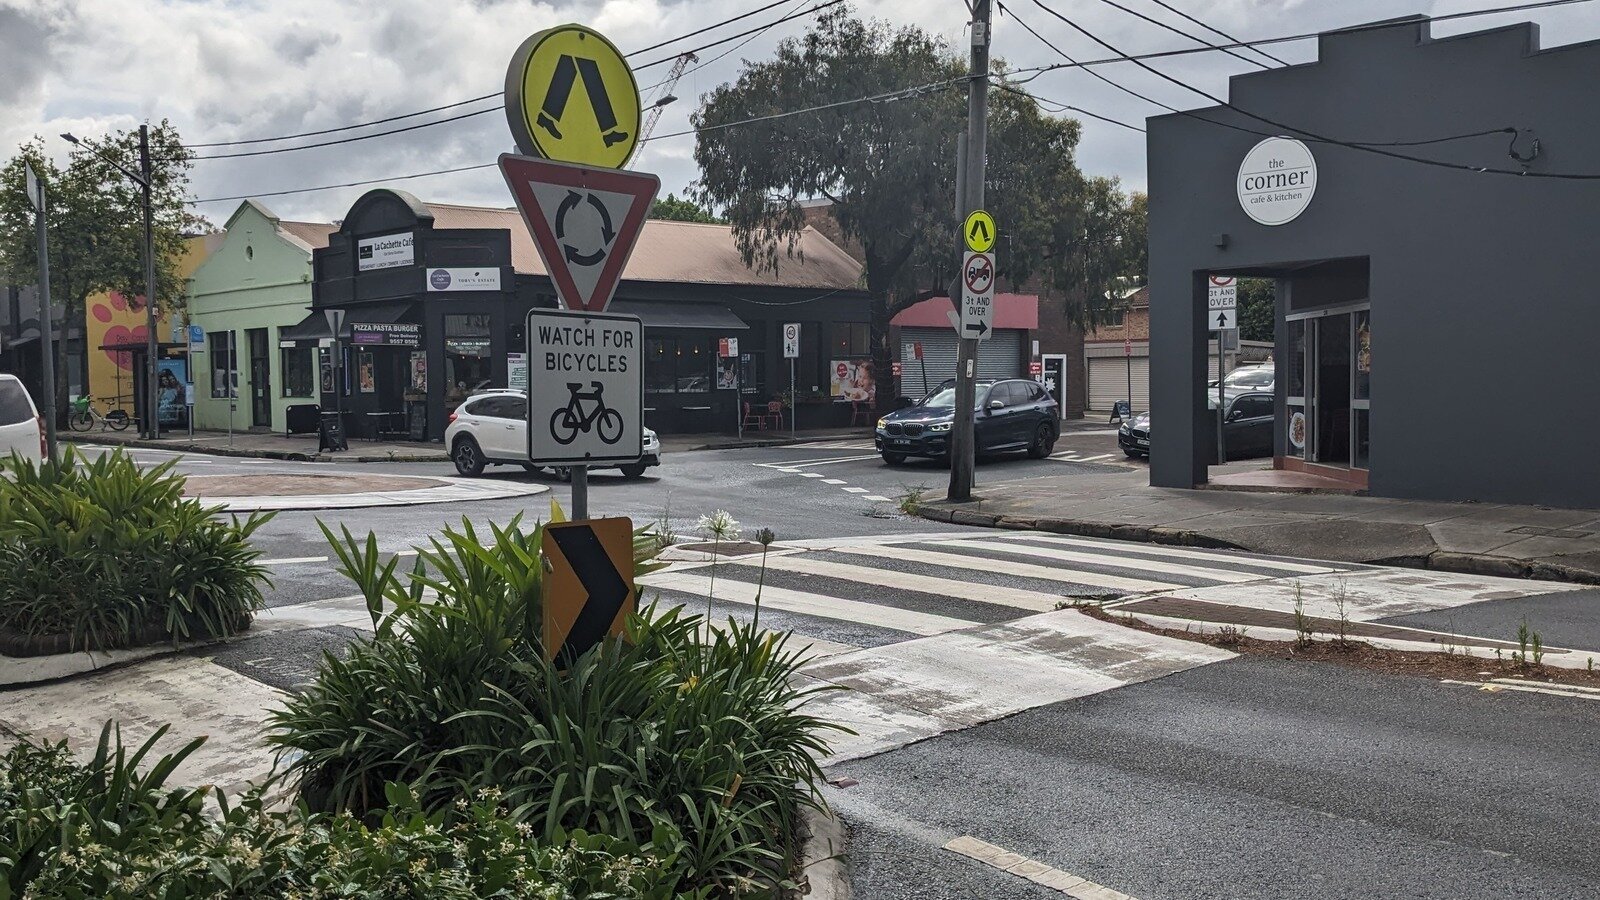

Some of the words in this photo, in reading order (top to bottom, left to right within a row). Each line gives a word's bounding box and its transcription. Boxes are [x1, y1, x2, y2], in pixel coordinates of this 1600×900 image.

[1269, 159, 1284, 169] the
[1245, 170, 1308, 191] corner
[1250, 195, 1265, 204] cafe
[1267, 194, 1273, 203] &
[1275, 192, 1302, 202] kitchen
[374, 242, 380, 251] La
[381, 240, 402, 250] Cachette
[1220, 288, 1235, 296] AND
[966, 296, 974, 305] 3t
[977, 297, 990, 306] AND
[1210, 297, 1234, 306] OVER
[969, 307, 986, 316] OVER
[539, 326, 595, 347] WATCH
[603, 330, 633, 348] FOR
[545, 352, 627, 373] BICYCLES
